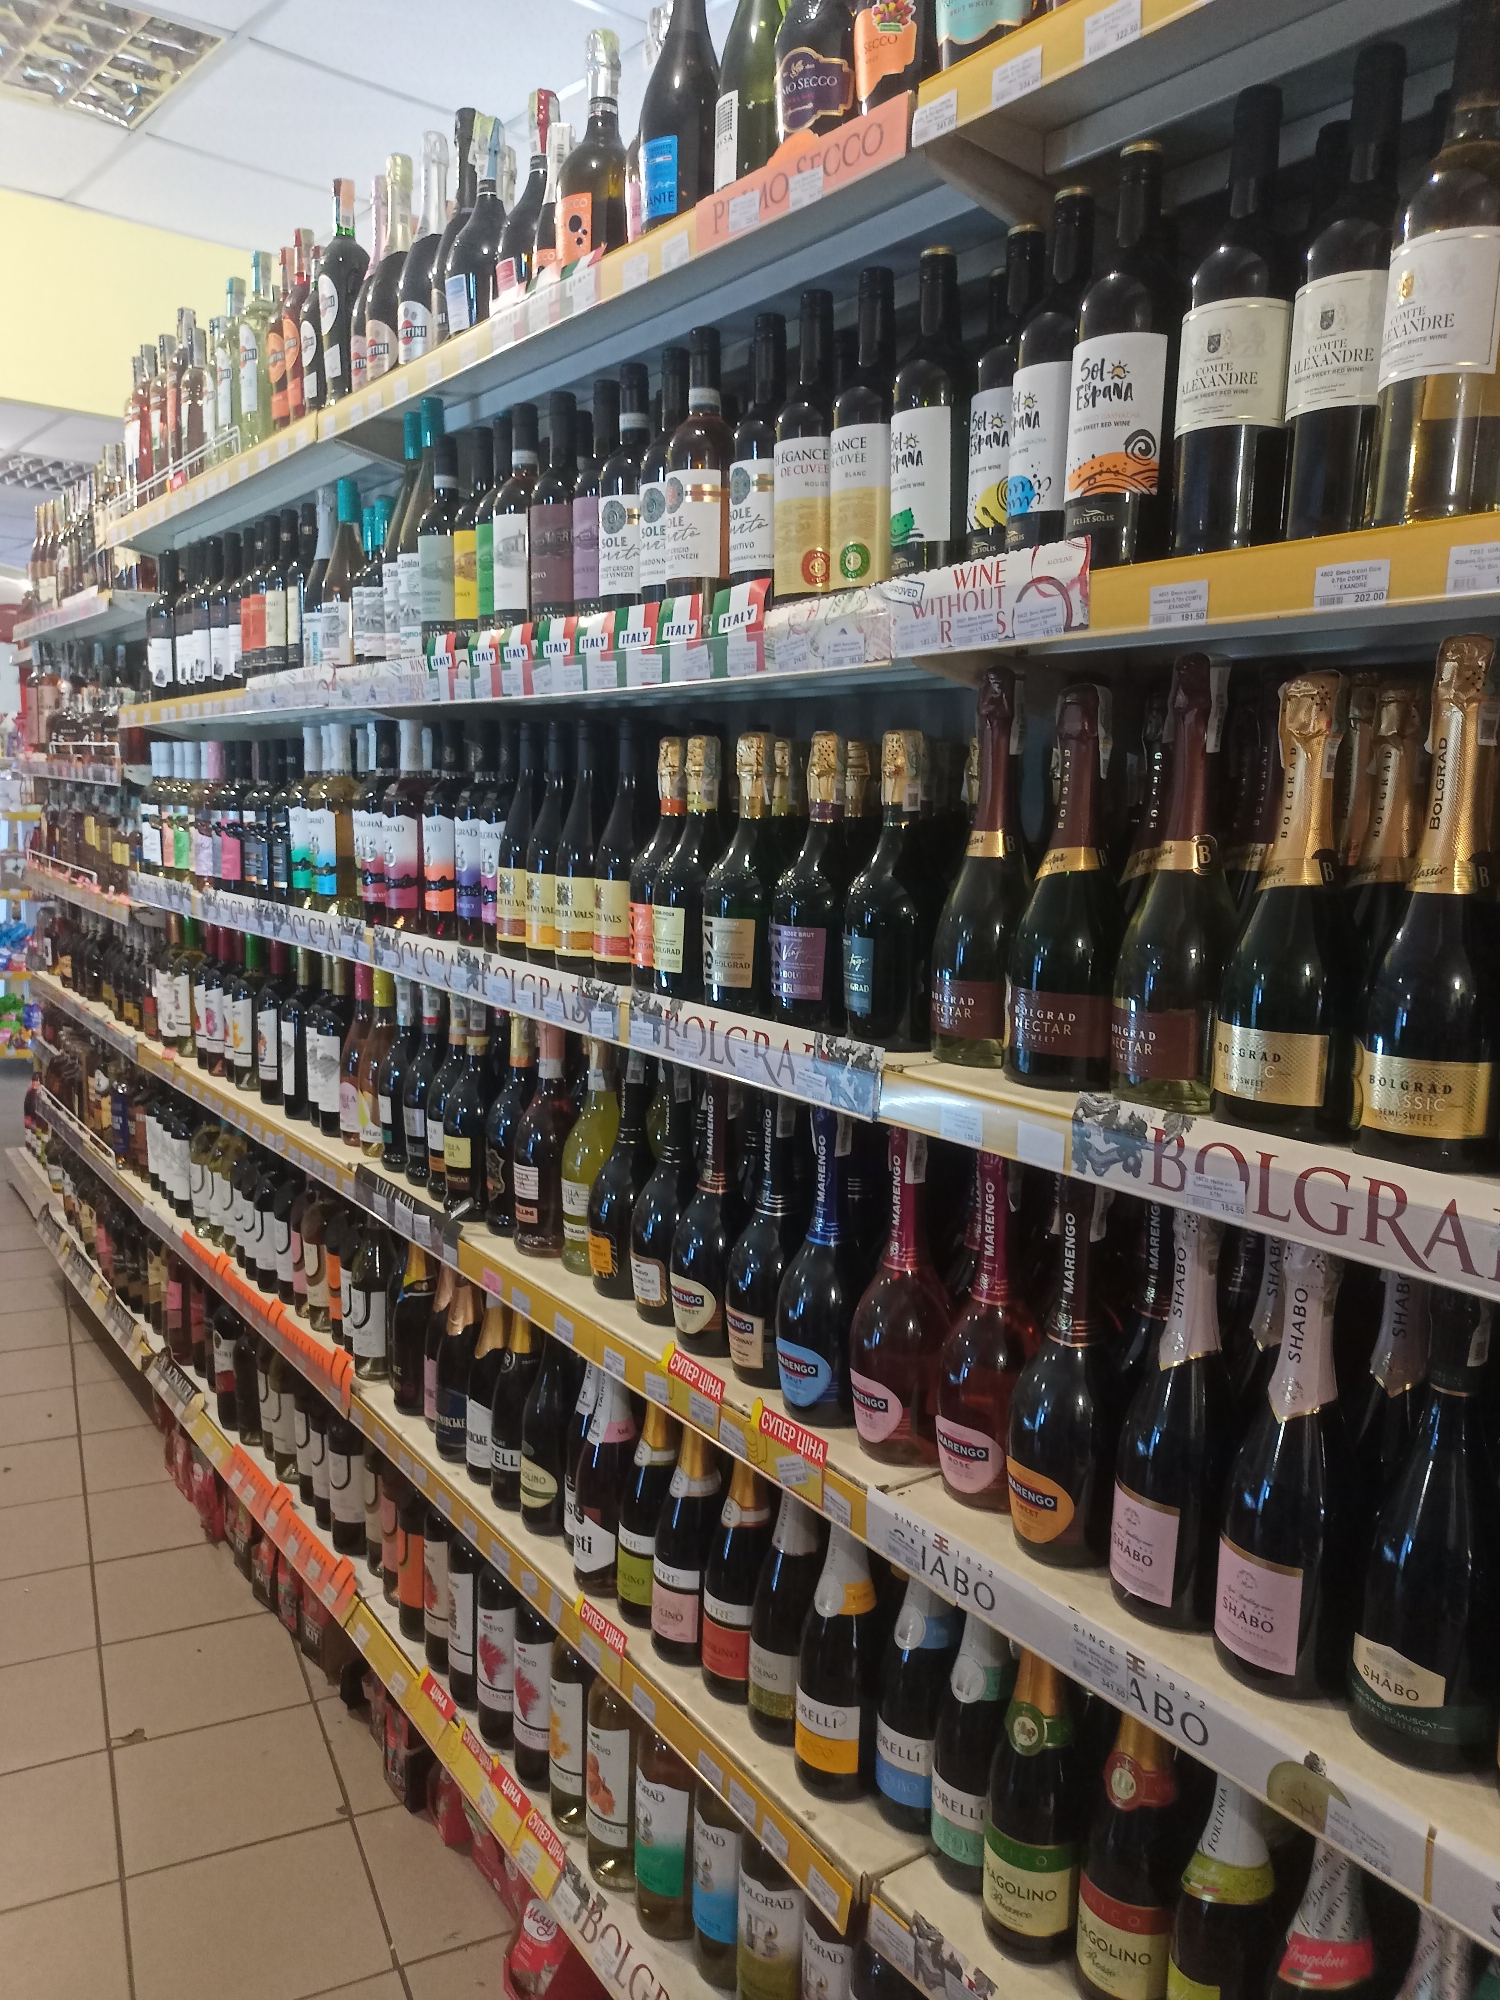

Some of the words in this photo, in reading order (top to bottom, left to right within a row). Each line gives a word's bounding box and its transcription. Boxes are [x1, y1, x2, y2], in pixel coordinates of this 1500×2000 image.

[797, 75, 837, 89] SECCO
[1308, 338, 1347, 355] COMTE
[1080, 358, 1106, 382] Sol
[1196, 362, 1234, 377] COMTE
[840, 453, 867, 467] CUVÉE
[780, 467, 791, 477] DE
[794, 464, 829, 476] CUVÉE
[844, 470, 867, 478] BLANC
[1073, 517, 1091, 525] FELIX
[1092, 515, 1114, 523] SOLIS
[602, 537, 628, 549] SOLE
[979, 545, 996, 553] SOLIS
[953, 560, 1007, 591] WINE
[911, 585, 1006, 620] WITHOUT
[1354, 592, 1385, 603] 202.00
[722, 609, 755, 627] ITALY
[1180, 613, 1205, 623] 191.50
[621, 631, 648, 643] ITALY
[666, 624, 694, 637] ITALY
[980, 632, 998, 642] 183.50
[545, 642, 568, 654] ITALY
[582, 636, 606, 649] ITALY
[432, 656, 450, 666] ITALY
[474, 651, 495, 662] ITALY
[505, 648, 526, 659] ITALY
[1058, 749, 1071, 829] BOLGRAD
[1280, 746, 1297, 839] BOLGRAD
[1428, 737, 1448, 831] BOLGRAD
[1373, 750, 1392, 838] BOLGRAD
[1199, 845, 1211, 864] B
[1322, 862, 1334, 882] B
[1479, 866, 1490, 888] B
[574, 910, 593, 918] VALS
[604, 914, 622, 923] VALS
[714, 961, 750, 969] BOLGRAD
[931, 991, 975, 1006] BOLGRAD
[932, 1005, 972, 1019] NECTAR
[1015, 1005, 1076, 1022] BOLGRAD
[1015, 1017, 1072, 1035] NECTAR
[1111, 1023, 1156, 1041] BOLGRAD
[1025, 1032, 1056, 1043] SWEET
[1112, 1037, 1153, 1055] NECTAR
[1218, 1041, 1282, 1063] BOLGRAD
[1222, 1072, 1265, 1088] SEMI-SWEET
[1369, 1074, 1453, 1095] BOLGRAD
[1378, 1107, 1433, 1122] SEMI-SWEET
[706, 1095, 715, 1156] MARENGO
[817, 1134, 828, 1202] MARENGO
[892, 1154, 902, 1227] MARENGO
[1148, 1125, 1500, 1283] BOLGRA
[1221, 1203, 1246, 1216] 154.50
[984, 1180, 996, 1258] MARENGO
[1063, 1212, 1078, 1295] MARENGO
[1173, 1247, 1188, 1318] SHABO
[1288, 1288, 1309, 1364] SHABO
[670, 1352, 699, 1382] СУПЕР
[698, 1376, 721, 1399] ЦІНА
[761, 1411, 795, 1443] СУПЕР
[796, 1431, 824, 1463] ЦІНА
[938, 1435, 986, 1459] MARENGO
[1008, 1477, 1055, 1507] MARENGO
[1016, 1502, 1038, 1517] SWEET
[894, 1512, 927, 1537] SINCE
[956, 1550, 994, 1578] 1822
[1114, 1532, 1153, 1567] SHABO
[1223, 1597, 1274, 1633] SHABO
[581, 1604, 605, 1631] СУПЕР
[605, 1627, 625, 1652] ЦІНА
[1073, 1623, 1116, 1655] SINCE
[1156, 1672, 1206, 1711] 1822
[1101, 1677, 1126, 1699] 341.50
[1362, 1663, 1420, 1702] SHABO
[429, 1684, 448, 1712] ЦІНА
[1384, 1715, 1429, 1736] EDITION
[1395, 1711, 1438, 1730] MUSCAT
[462, 1727, 478, 1753] СУПЕР
[477, 1752, 493, 1775] ЦІНА
[500, 1777, 521, 1807] ЦІНА
[1207, 1786, 1228, 1853] FORTINIA
[528, 1813, 550, 1845] СУПЕР
[546, 1840, 565, 1867] ЦІНА
